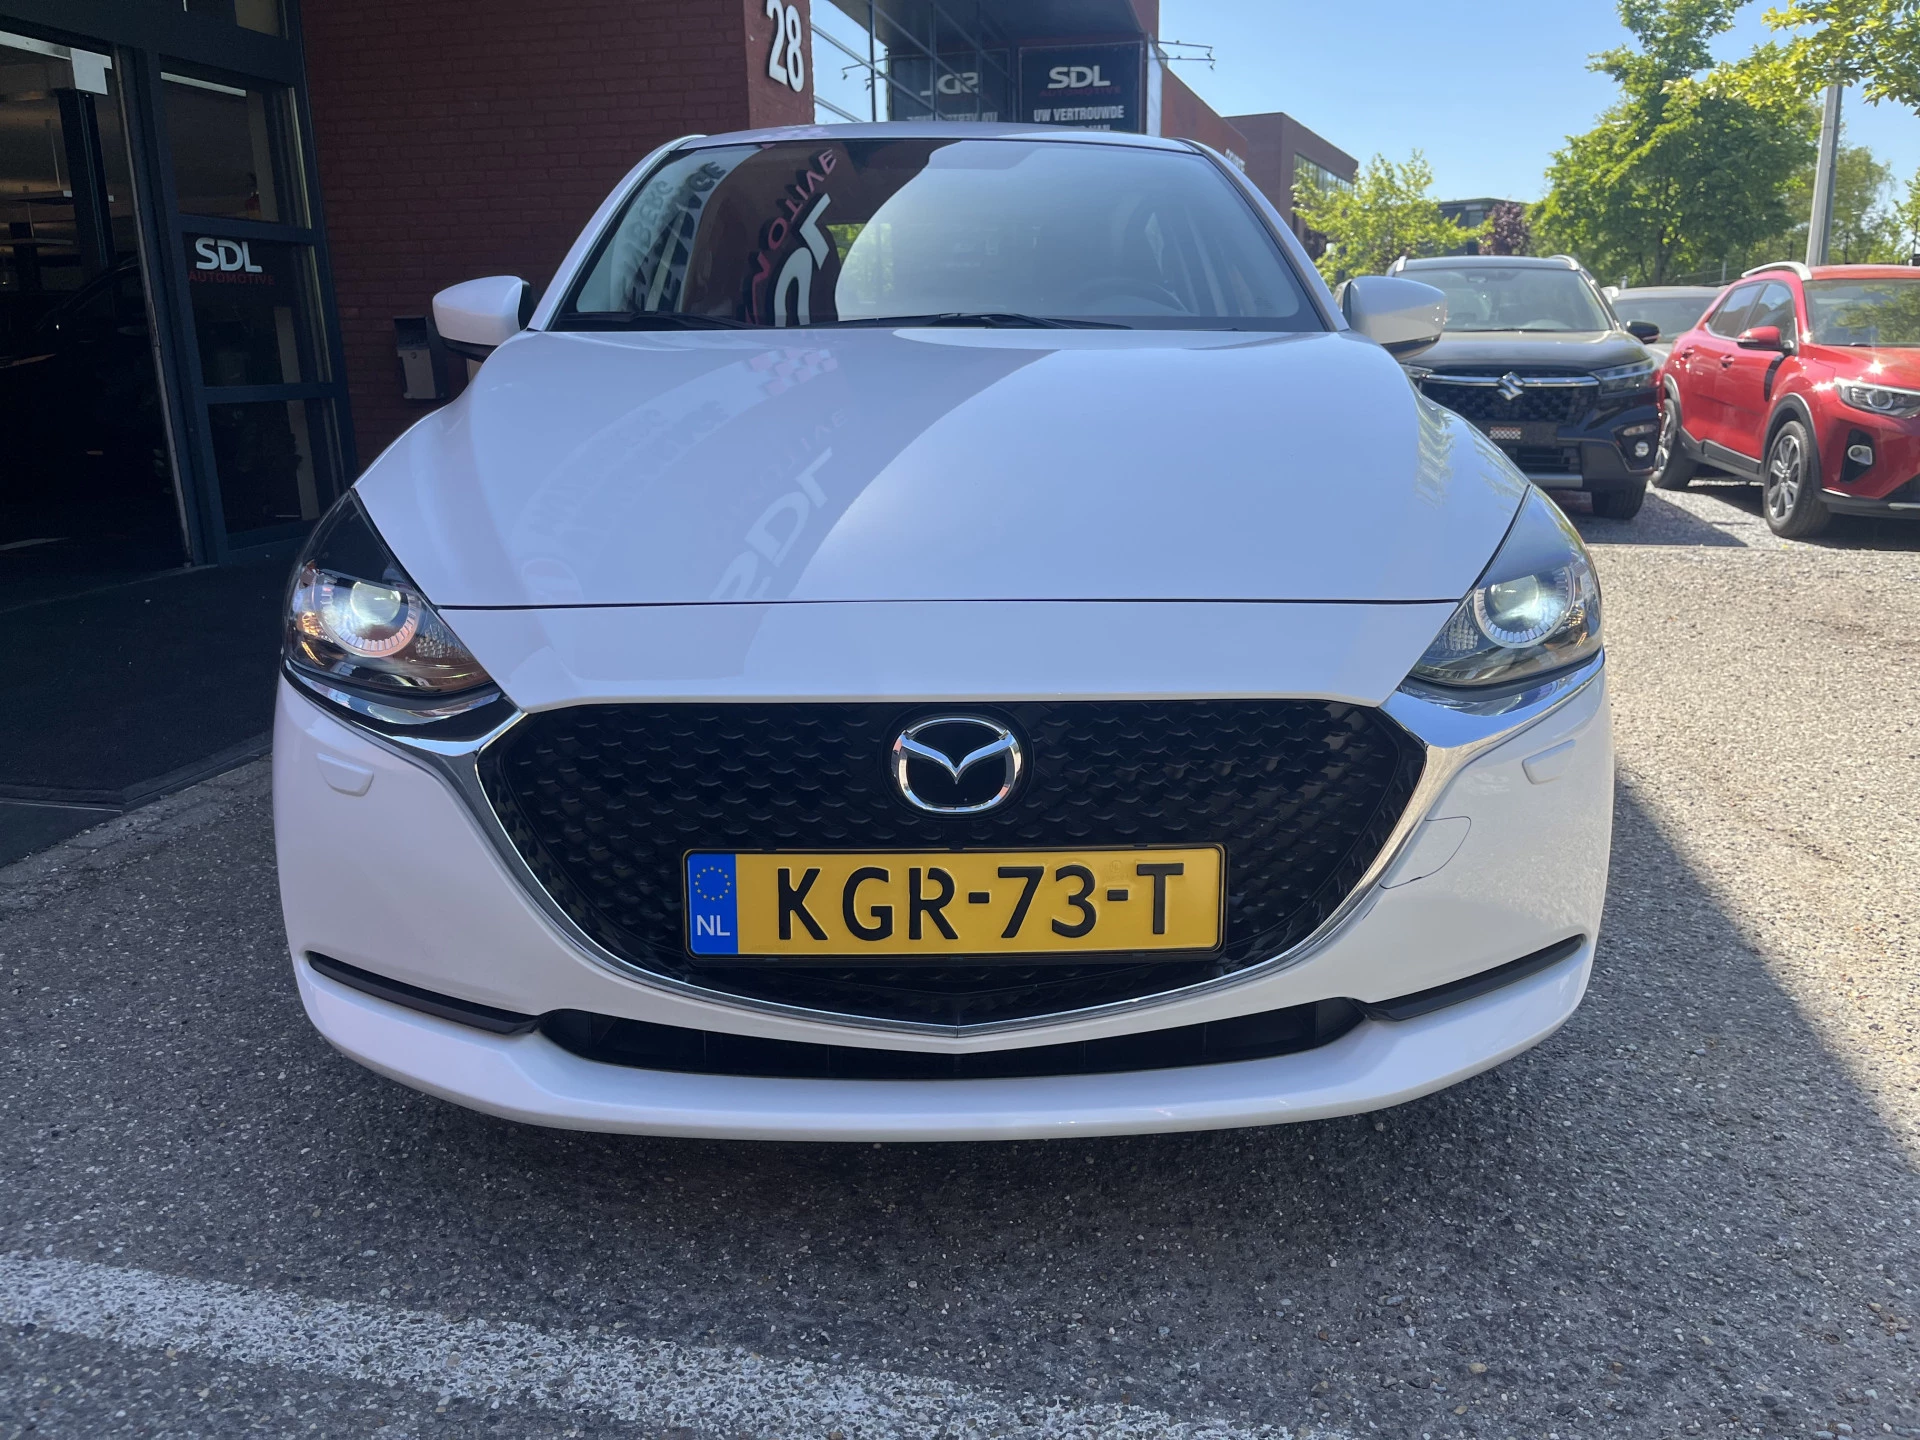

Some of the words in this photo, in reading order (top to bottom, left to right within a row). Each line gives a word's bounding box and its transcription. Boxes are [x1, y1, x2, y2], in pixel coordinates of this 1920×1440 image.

[766, 0, 804, 92] 28
[1047, 65, 1111, 89] SDL
[1033, 108, 1052, 122] UW
[1053, 105, 1124, 121] VERTROUWDE
[195, 237, 263, 273] SDL
[188, 270, 276, 285] AUTOMOTIVE
[777, 862, 1184, 942] KGR-73-T
[696, 914, 731, 937] NL
